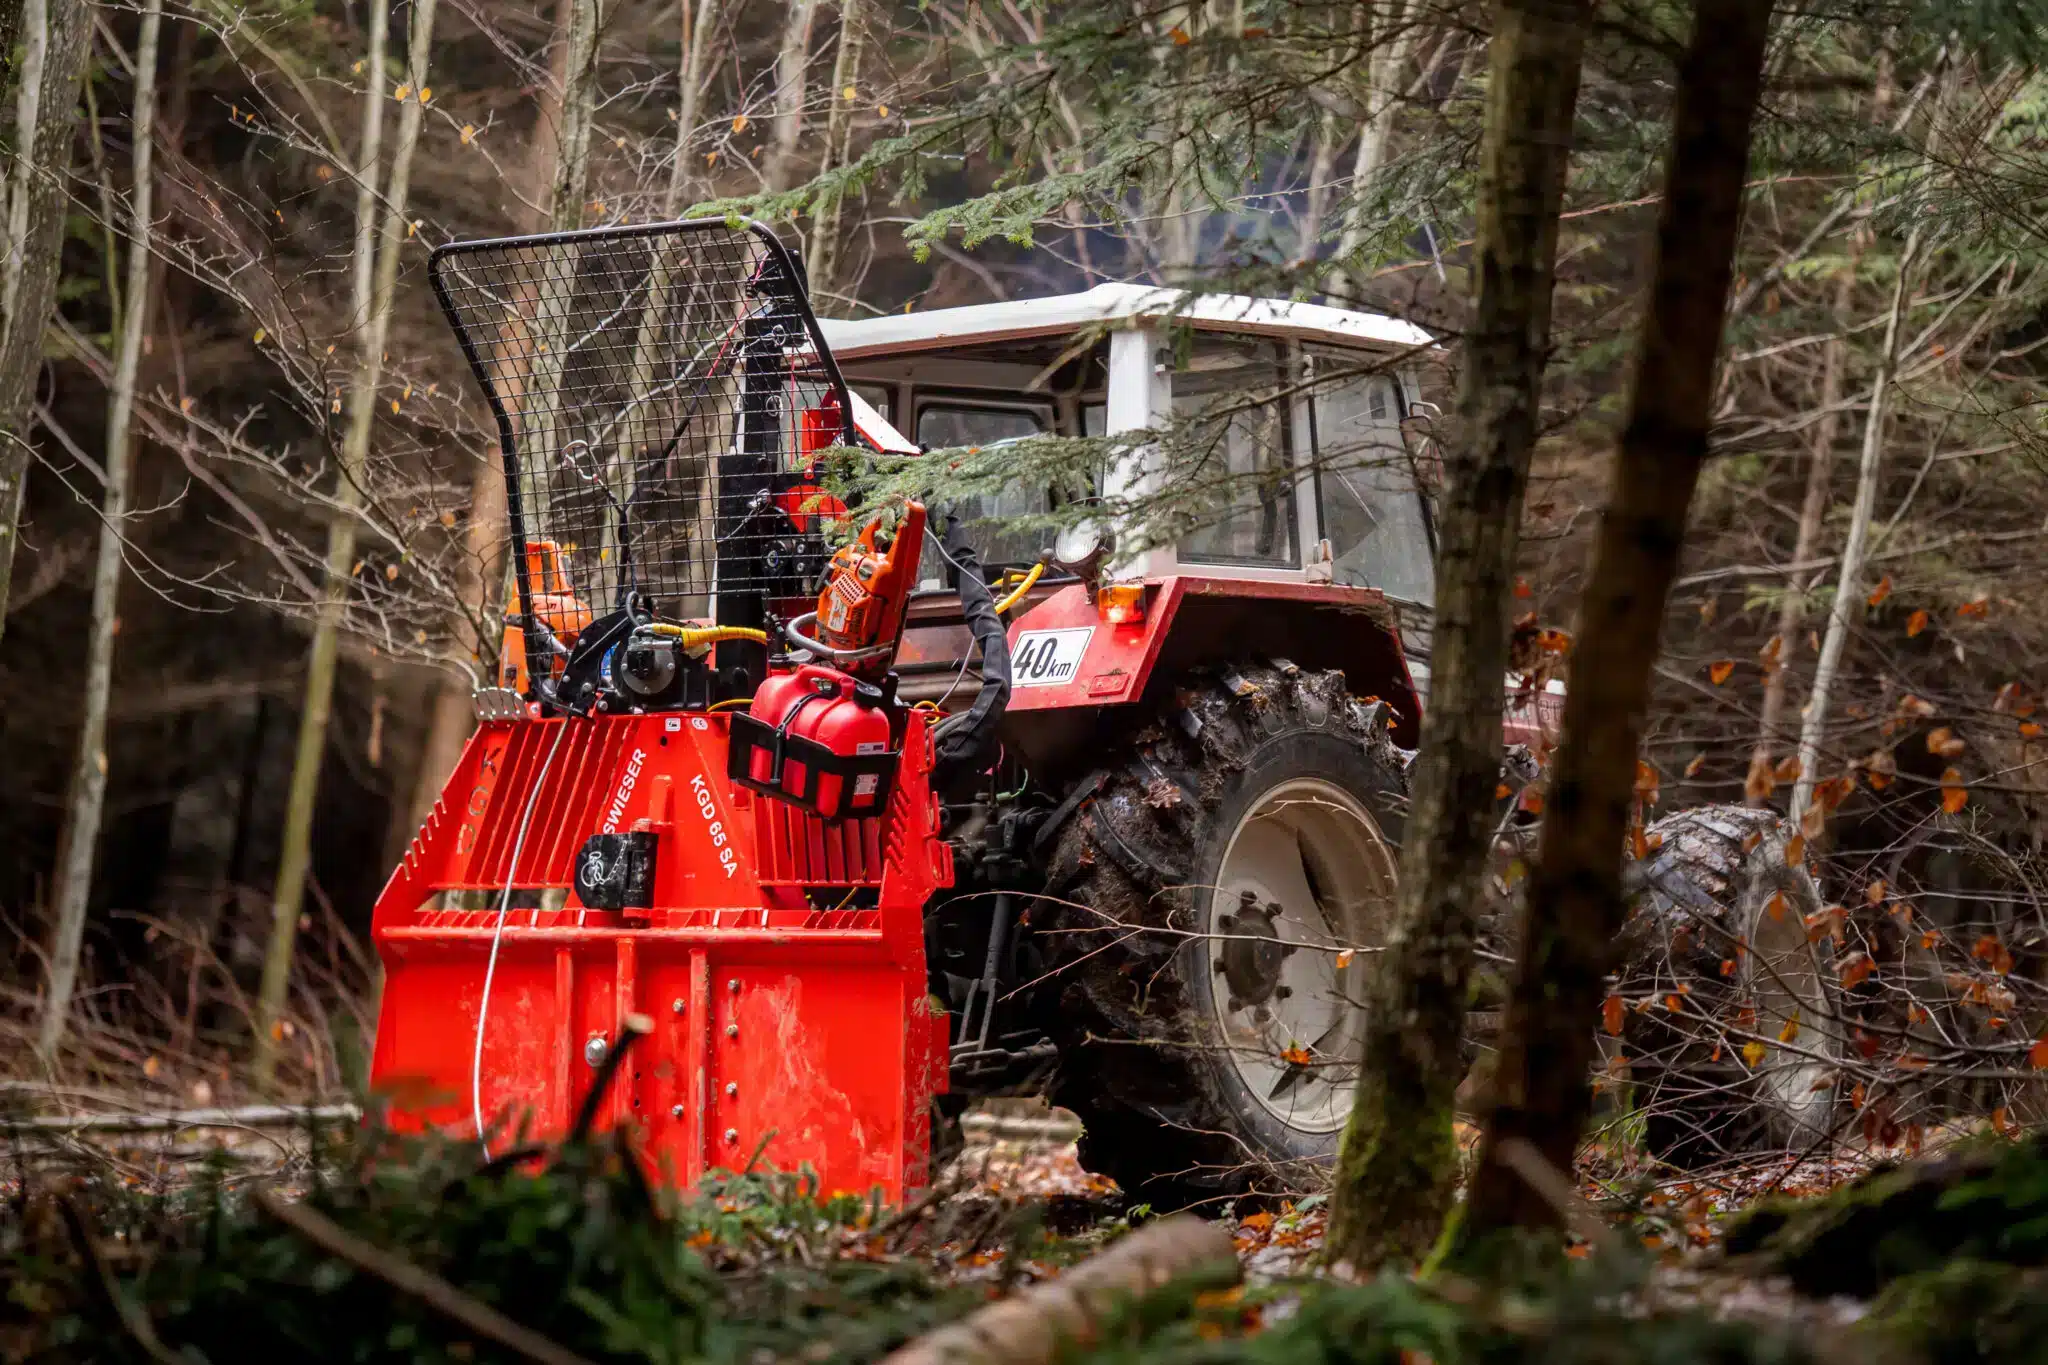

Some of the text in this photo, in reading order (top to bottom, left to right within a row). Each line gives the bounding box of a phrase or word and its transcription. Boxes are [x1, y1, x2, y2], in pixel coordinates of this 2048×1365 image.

[1013, 637, 1072, 679] 40 km
[602, 748, 647, 834] SWIESER
[690, 773, 738, 878] KGD 65 SA
